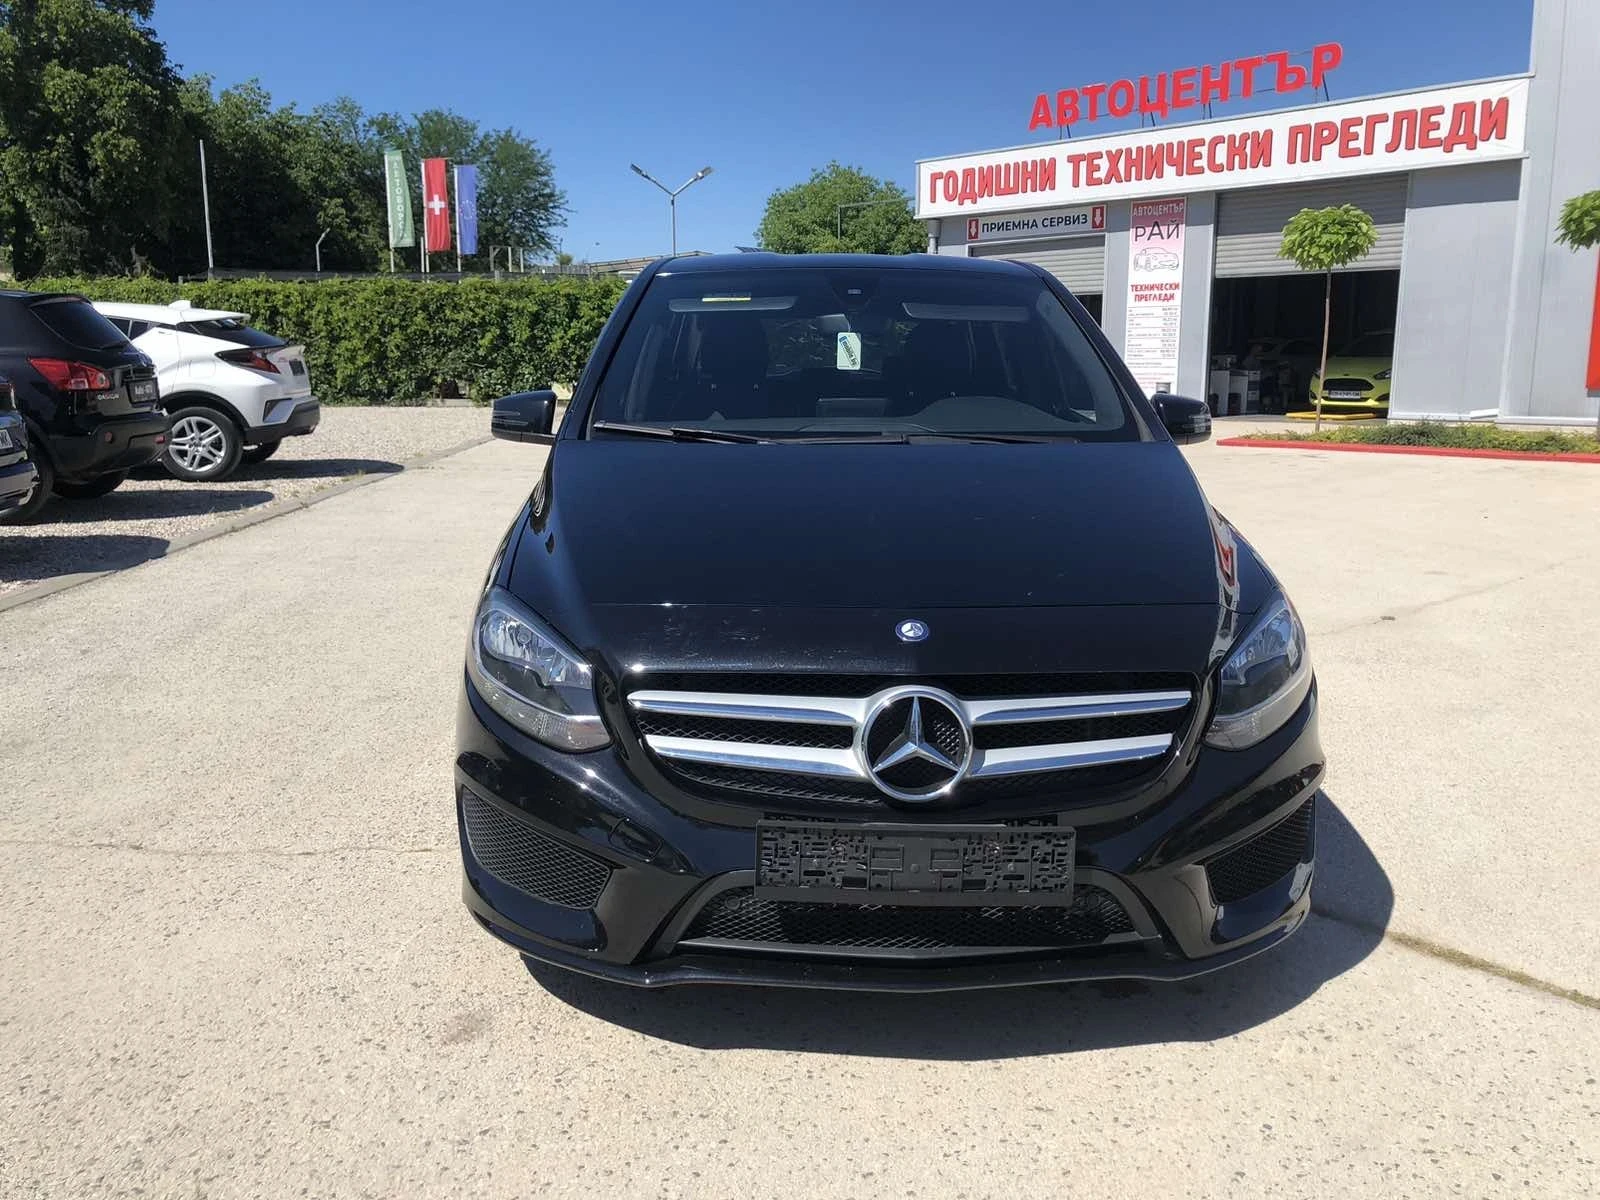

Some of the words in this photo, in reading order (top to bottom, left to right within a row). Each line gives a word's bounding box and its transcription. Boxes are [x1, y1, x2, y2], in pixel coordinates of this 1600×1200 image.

[1029, 43, 1343, 131] АВТОЦЕНТЪР
[929, 157, 1057, 204] ГОДИШНИ
[1067, 129, 1273, 188] ТЕХНИЧЕСКИ
[1287, 97, 1509, 165] ПРЕГЛЕДИ
[1133, 202, 1184, 216] АВТОЦЕНТЪР
[981, 219, 1039, 233] ПРИЕМНА
[1041, 213, 1088, 228] СЕРВИЗ
[1134, 219, 1180, 242] РАЙ
[1130, 282, 1180, 292] ТЕХНИЧЕСКИ
[1134, 293, 1175, 302] ПРЕГЛЕДИ
